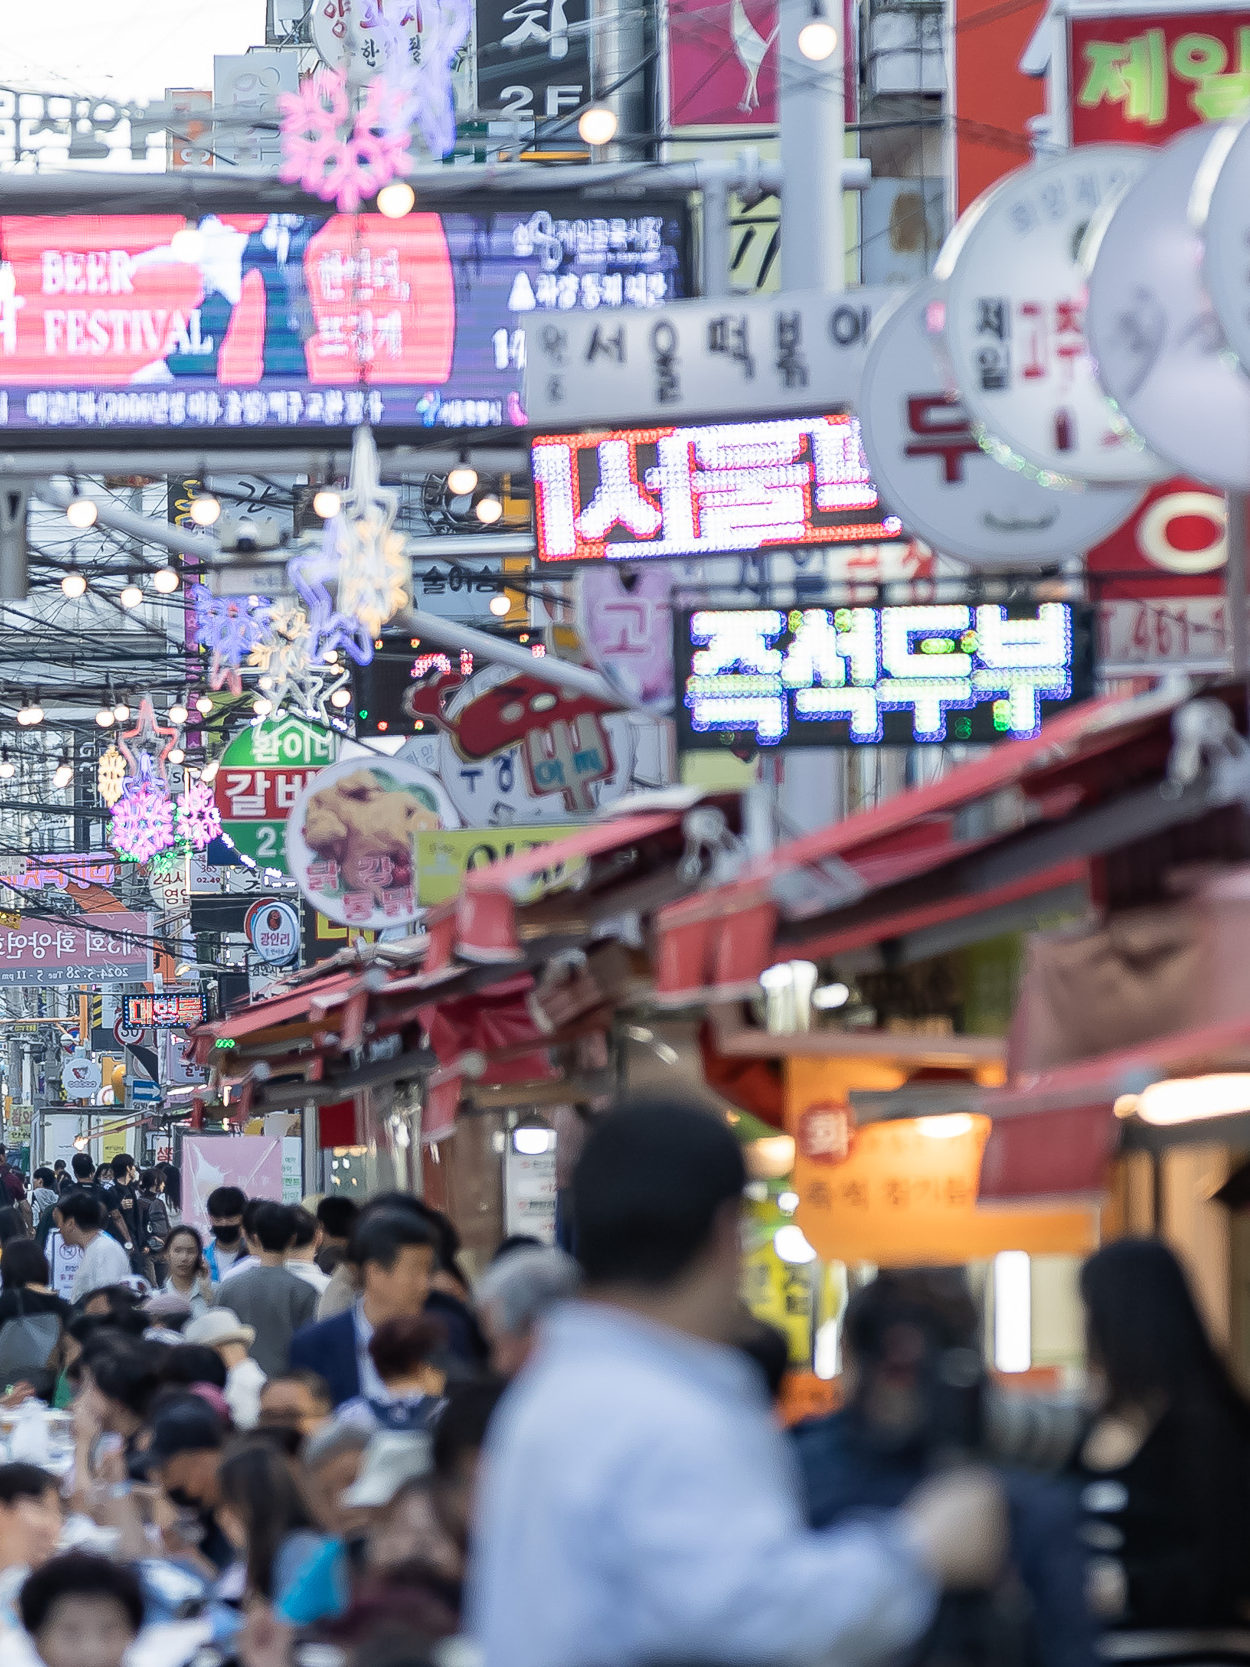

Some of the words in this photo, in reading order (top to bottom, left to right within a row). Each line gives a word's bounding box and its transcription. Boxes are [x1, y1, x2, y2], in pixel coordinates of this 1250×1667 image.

[500, 85, 583, 116] 2F
[40, 249, 137, 297] BEER
[43, 308, 214, 357] FESTIVAL
[686, 602, 1075, 745] 즉석두부
